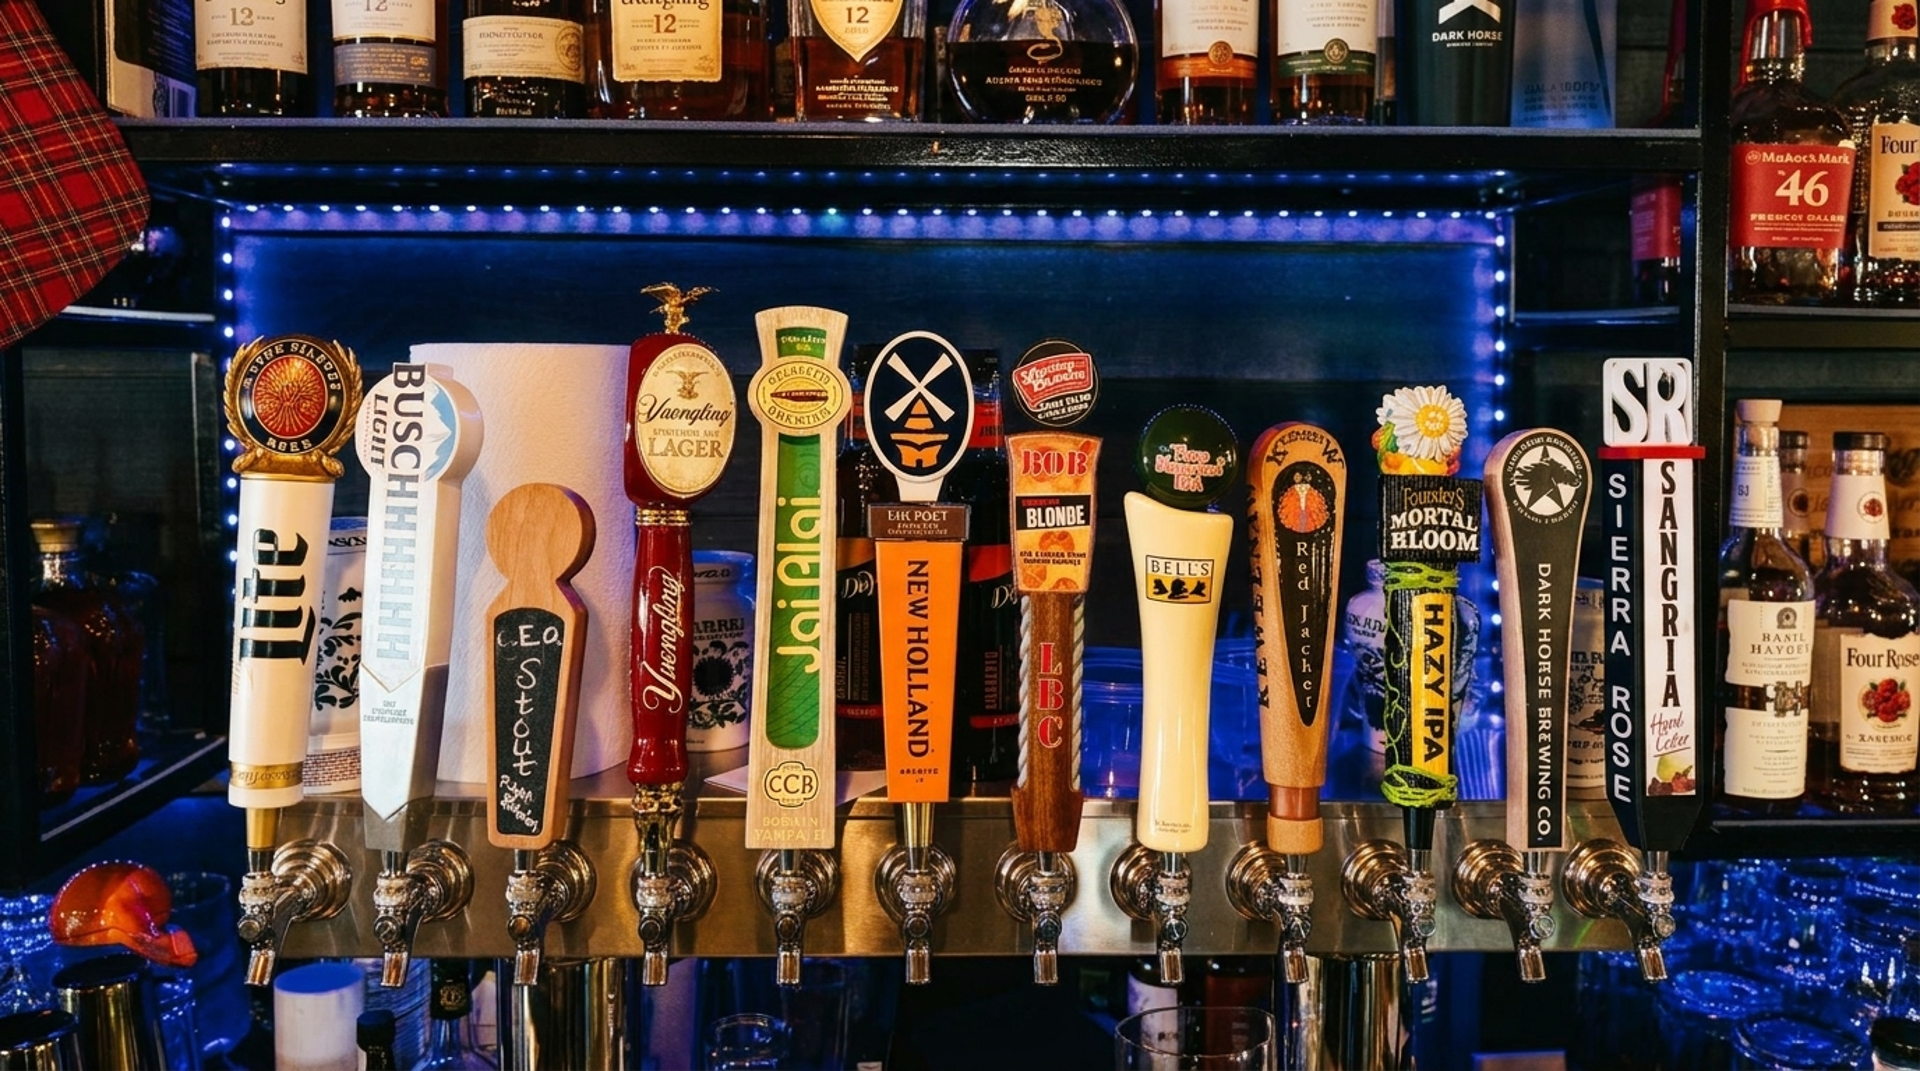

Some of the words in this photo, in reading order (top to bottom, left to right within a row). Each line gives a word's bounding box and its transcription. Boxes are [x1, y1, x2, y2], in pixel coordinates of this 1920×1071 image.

[230, 7, 254, 26] 12
[653, 13, 677, 34] 12
[845, 6, 869, 24] 12
[1432, 31, 1464, 42] DARK
[1881, 135, 1919, 154] Four
[1775, 169, 1829, 207] 46
[648, 437, 724, 458] LAGER
[914, 510, 949, 521] POET
[1390, 507, 1478, 532] MORTAL
[1390, 529, 1479, 552] BLOOM
[907, 560, 929, 620] NEW
[1150, 560, 1210, 577] BELL'S
[1297, 542, 1310, 591] Red
[1608, 473, 1631, 657] SIERRA
[1658, 460, 1681, 708] SANGRIA
[240, 528, 316, 666] Lite
[1538, 563, 1551, 621] DARK
[776, 598, 821, 674] Jai
[1423, 603, 1445, 698] HAZY
[1846, 647, 1884, 668] Four
[1538, 628, 1551, 699] HORSE
[512, 658, 542, 777] Stout
[906, 626, 929, 759] HOLLAND
[1037, 642, 1064, 749] LBC
[1423, 707, 1445, 763] IPA
[1538, 707, 1552, 800] BREWING
[1611, 685, 1633, 803] ROSE
[769, 773, 814, 795] CCB
